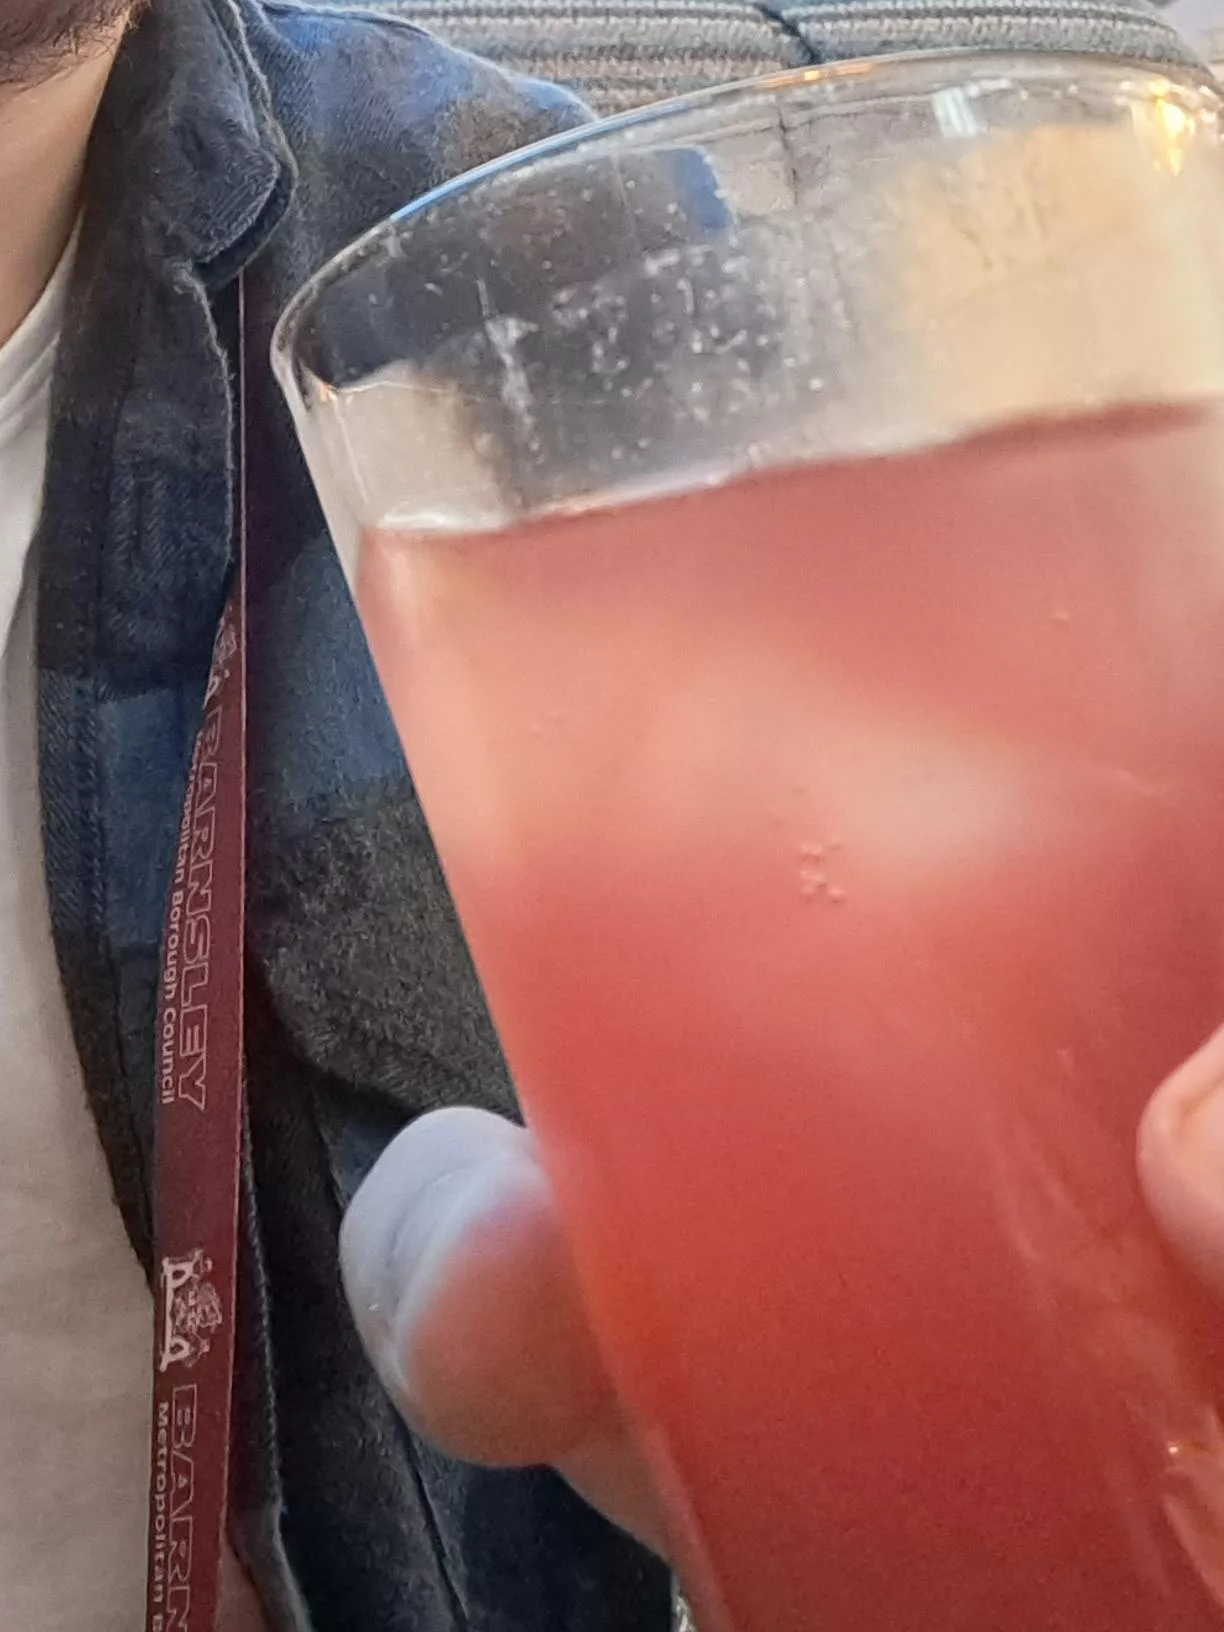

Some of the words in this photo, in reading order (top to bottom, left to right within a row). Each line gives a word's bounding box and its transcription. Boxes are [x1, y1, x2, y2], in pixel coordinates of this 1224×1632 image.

[164, 891, 183, 1000] Borough
[179, 706, 222, 1110] BARNSLEY
[162, 1007, 176, 1104] Council
[153, 1402, 169, 1603] Metropolitan
